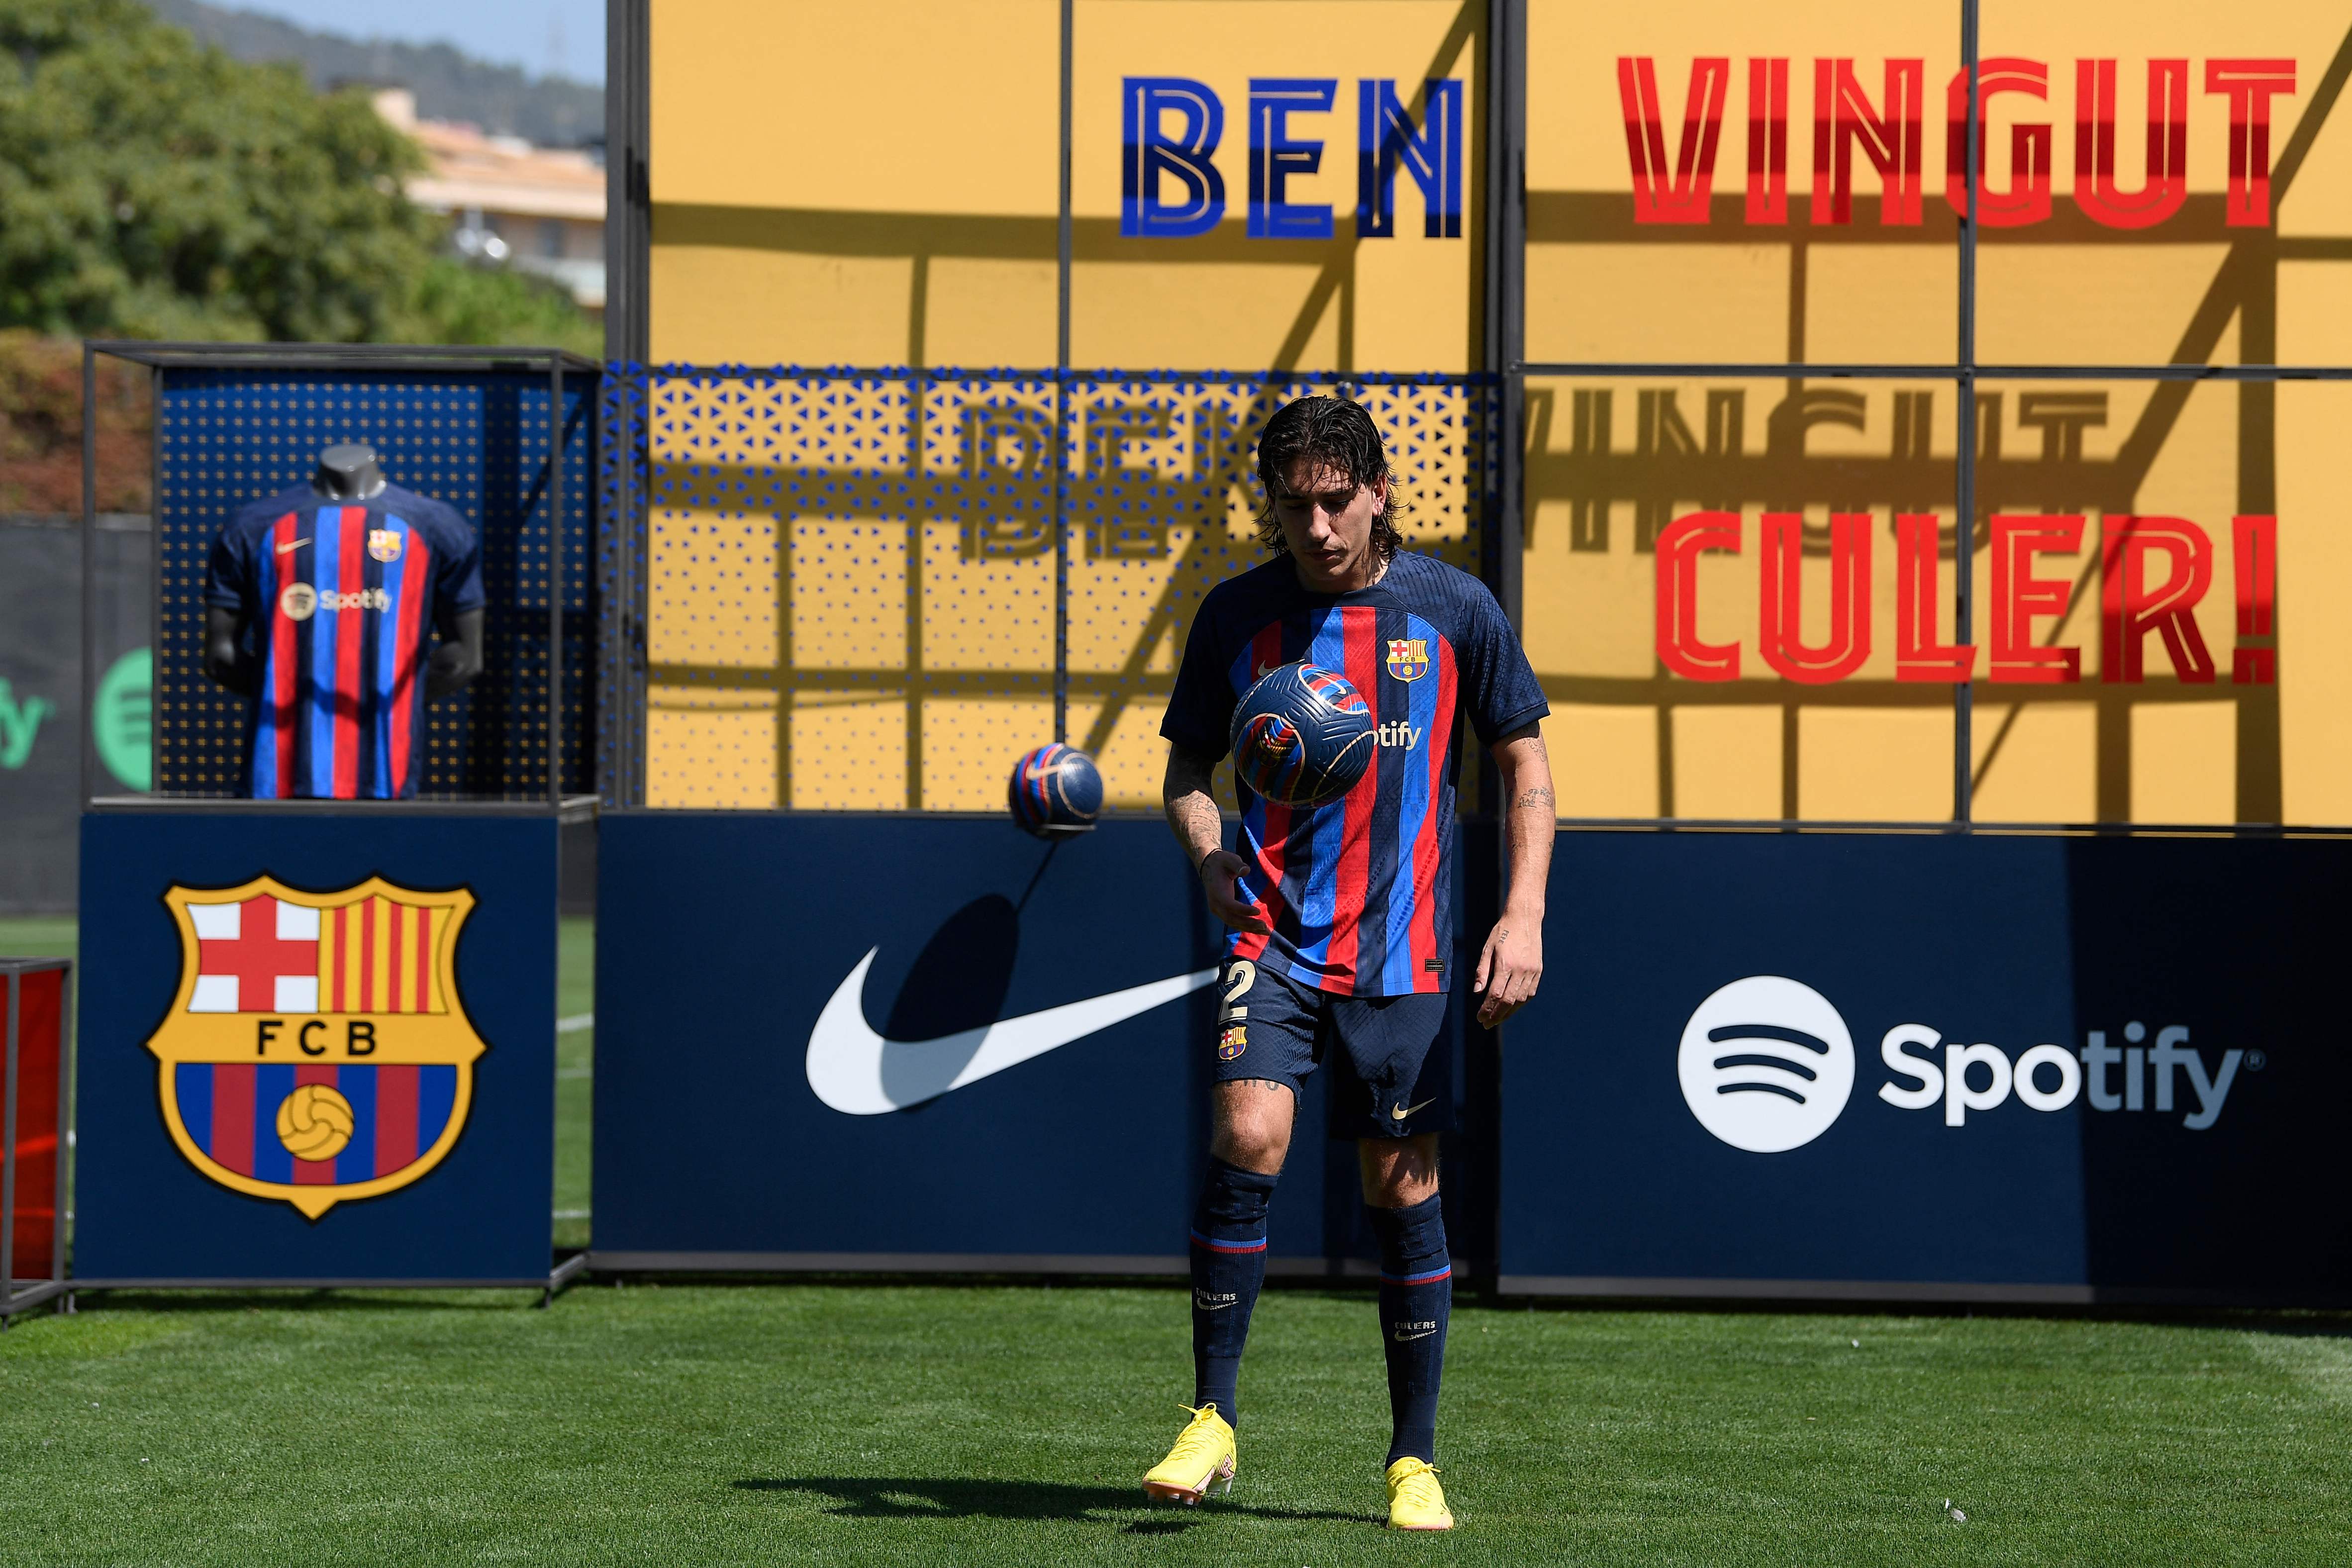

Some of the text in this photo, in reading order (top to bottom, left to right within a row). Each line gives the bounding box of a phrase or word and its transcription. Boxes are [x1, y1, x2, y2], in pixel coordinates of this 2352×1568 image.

[1119, 55, 2297, 238] BEN VINGUT
[319, 587, 393, 613] Spotify
[1655, 510, 2278, 686] CULER!
[1373, 720, 1422, 751] tify
[1219, 961, 1256, 1025] 2
[258, 1020, 376, 1056] FCB
